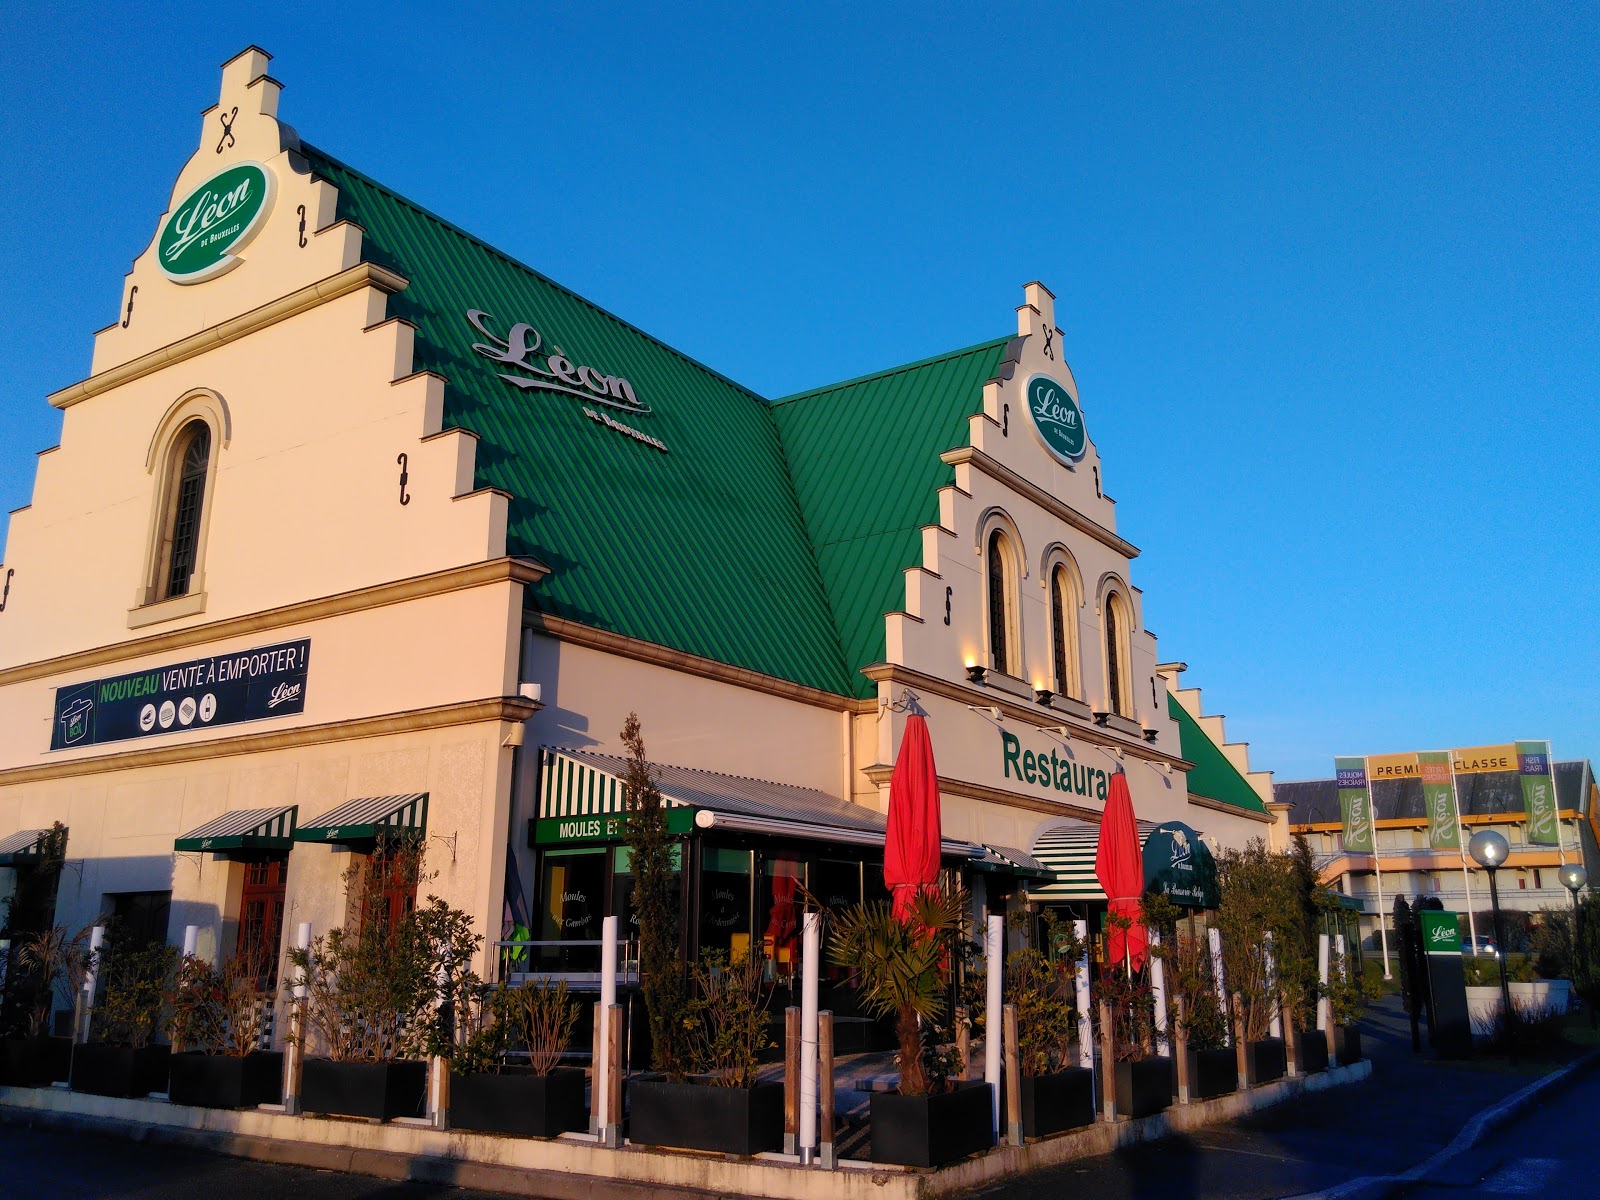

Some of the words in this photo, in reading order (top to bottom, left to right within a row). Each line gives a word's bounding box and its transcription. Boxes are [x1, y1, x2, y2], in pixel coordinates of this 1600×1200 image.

[165, 178, 254, 262] Léon
[200, 240, 209, 248] DE
[100, 673, 161, 703] NOUVEAU
[162, 664, 206, 692] VENTE
[205, 657, 216, 684] À
[218, 647, 297, 682] EMPORTER
[267, 681, 302, 708] Léon
[1003, 732, 1112, 801] Restaura
[1377, 764, 1419, 776] PREMI
[1454, 757, 1508, 771] CLASSE
[559, 820, 601, 838] MOULES
